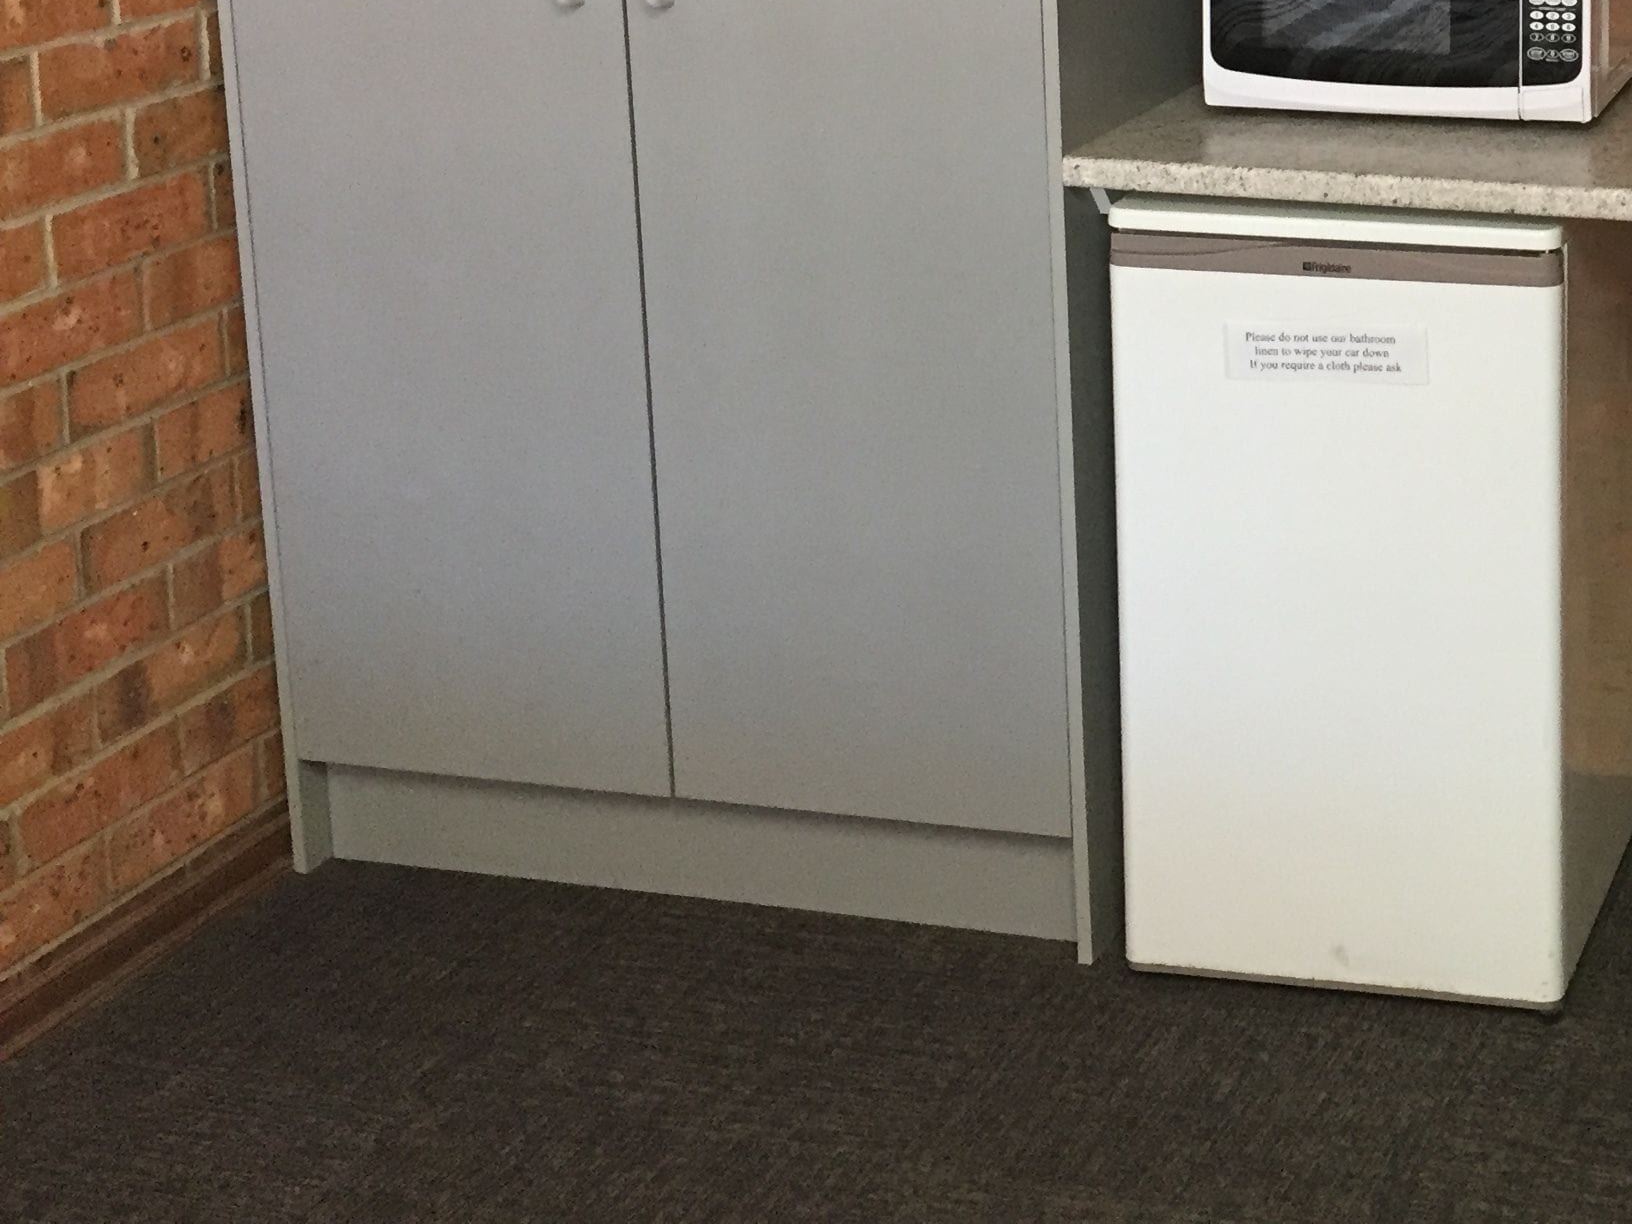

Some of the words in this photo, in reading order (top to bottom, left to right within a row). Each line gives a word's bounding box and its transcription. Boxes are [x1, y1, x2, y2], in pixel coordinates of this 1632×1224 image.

[1245, 332, 1276, 342] Please
[1278, 332, 1291, 342] do
[1294, 333, 1309, 342] not
[1312, 335, 1328, 343] use
[1331, 335, 1346, 343] our
[1349, 333, 1396, 344] bathroom
[1255, 346, 1279, 356] linen
[1281, 347, 1291, 356] to
[1294, 348, 1317, 358] wipe
[1320, 349, 1342, 358] your
[1345, 349, 1359, 357] car
[1362, 348, 1389, 358] down
[1250, 360, 1257, 369] If
[1260, 361, 1279, 371] you
[1281, 361, 1315, 372] require
[1326, 361, 1351, 371] cloth
[1353, 361, 1383, 373] please
[1386, 362, 1402, 372] ask
